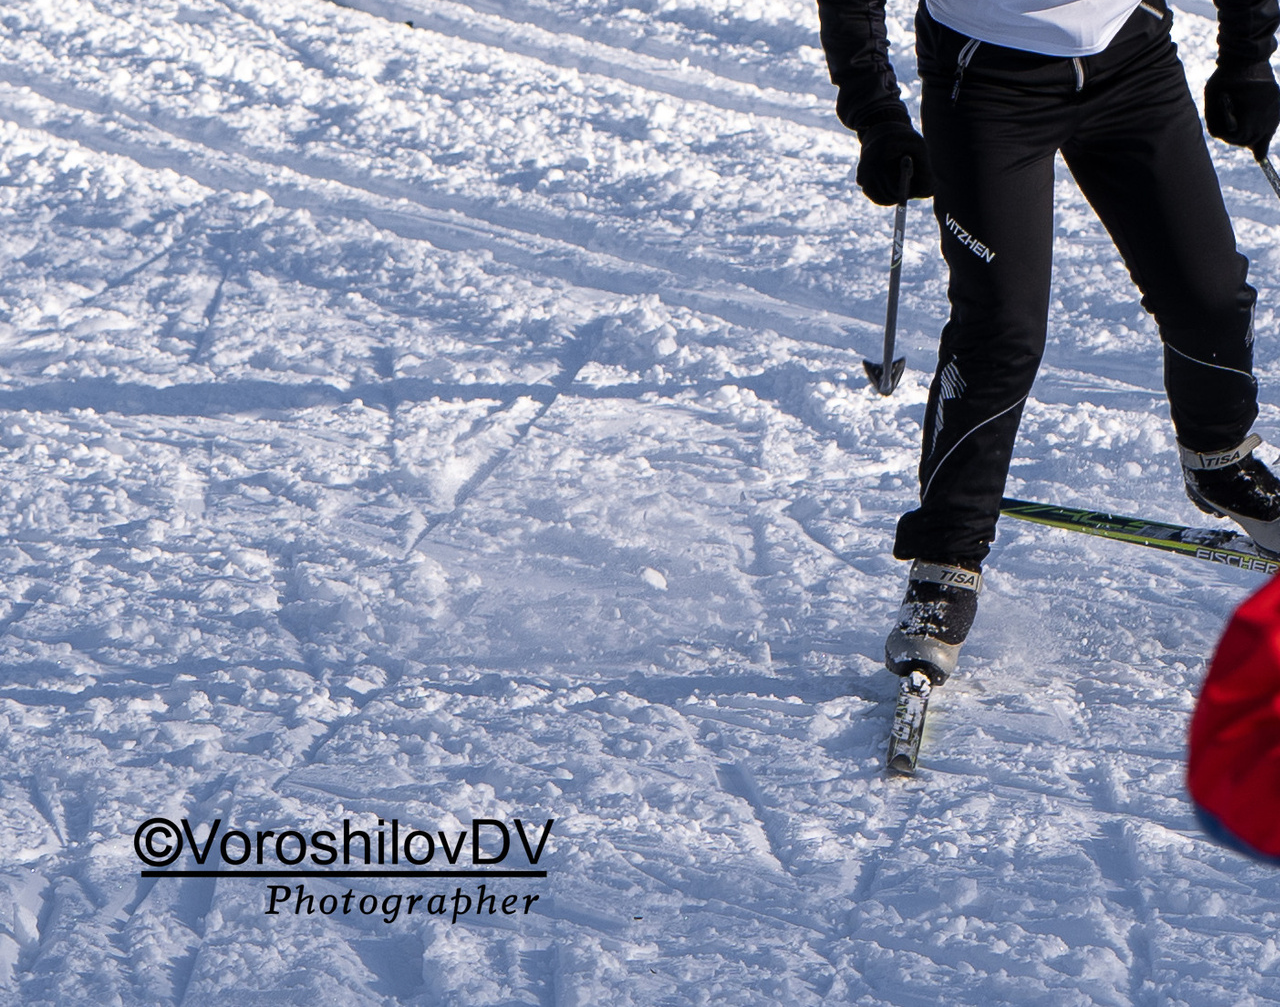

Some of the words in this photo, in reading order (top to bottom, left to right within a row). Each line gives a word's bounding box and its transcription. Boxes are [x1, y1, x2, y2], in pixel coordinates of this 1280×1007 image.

[945, 213, 996, 263] VITZHEN
[1205, 451, 1240, 467] TISA
[1196, 548, 1279, 574] FISCHER
[940, 570, 975, 586] TISA
